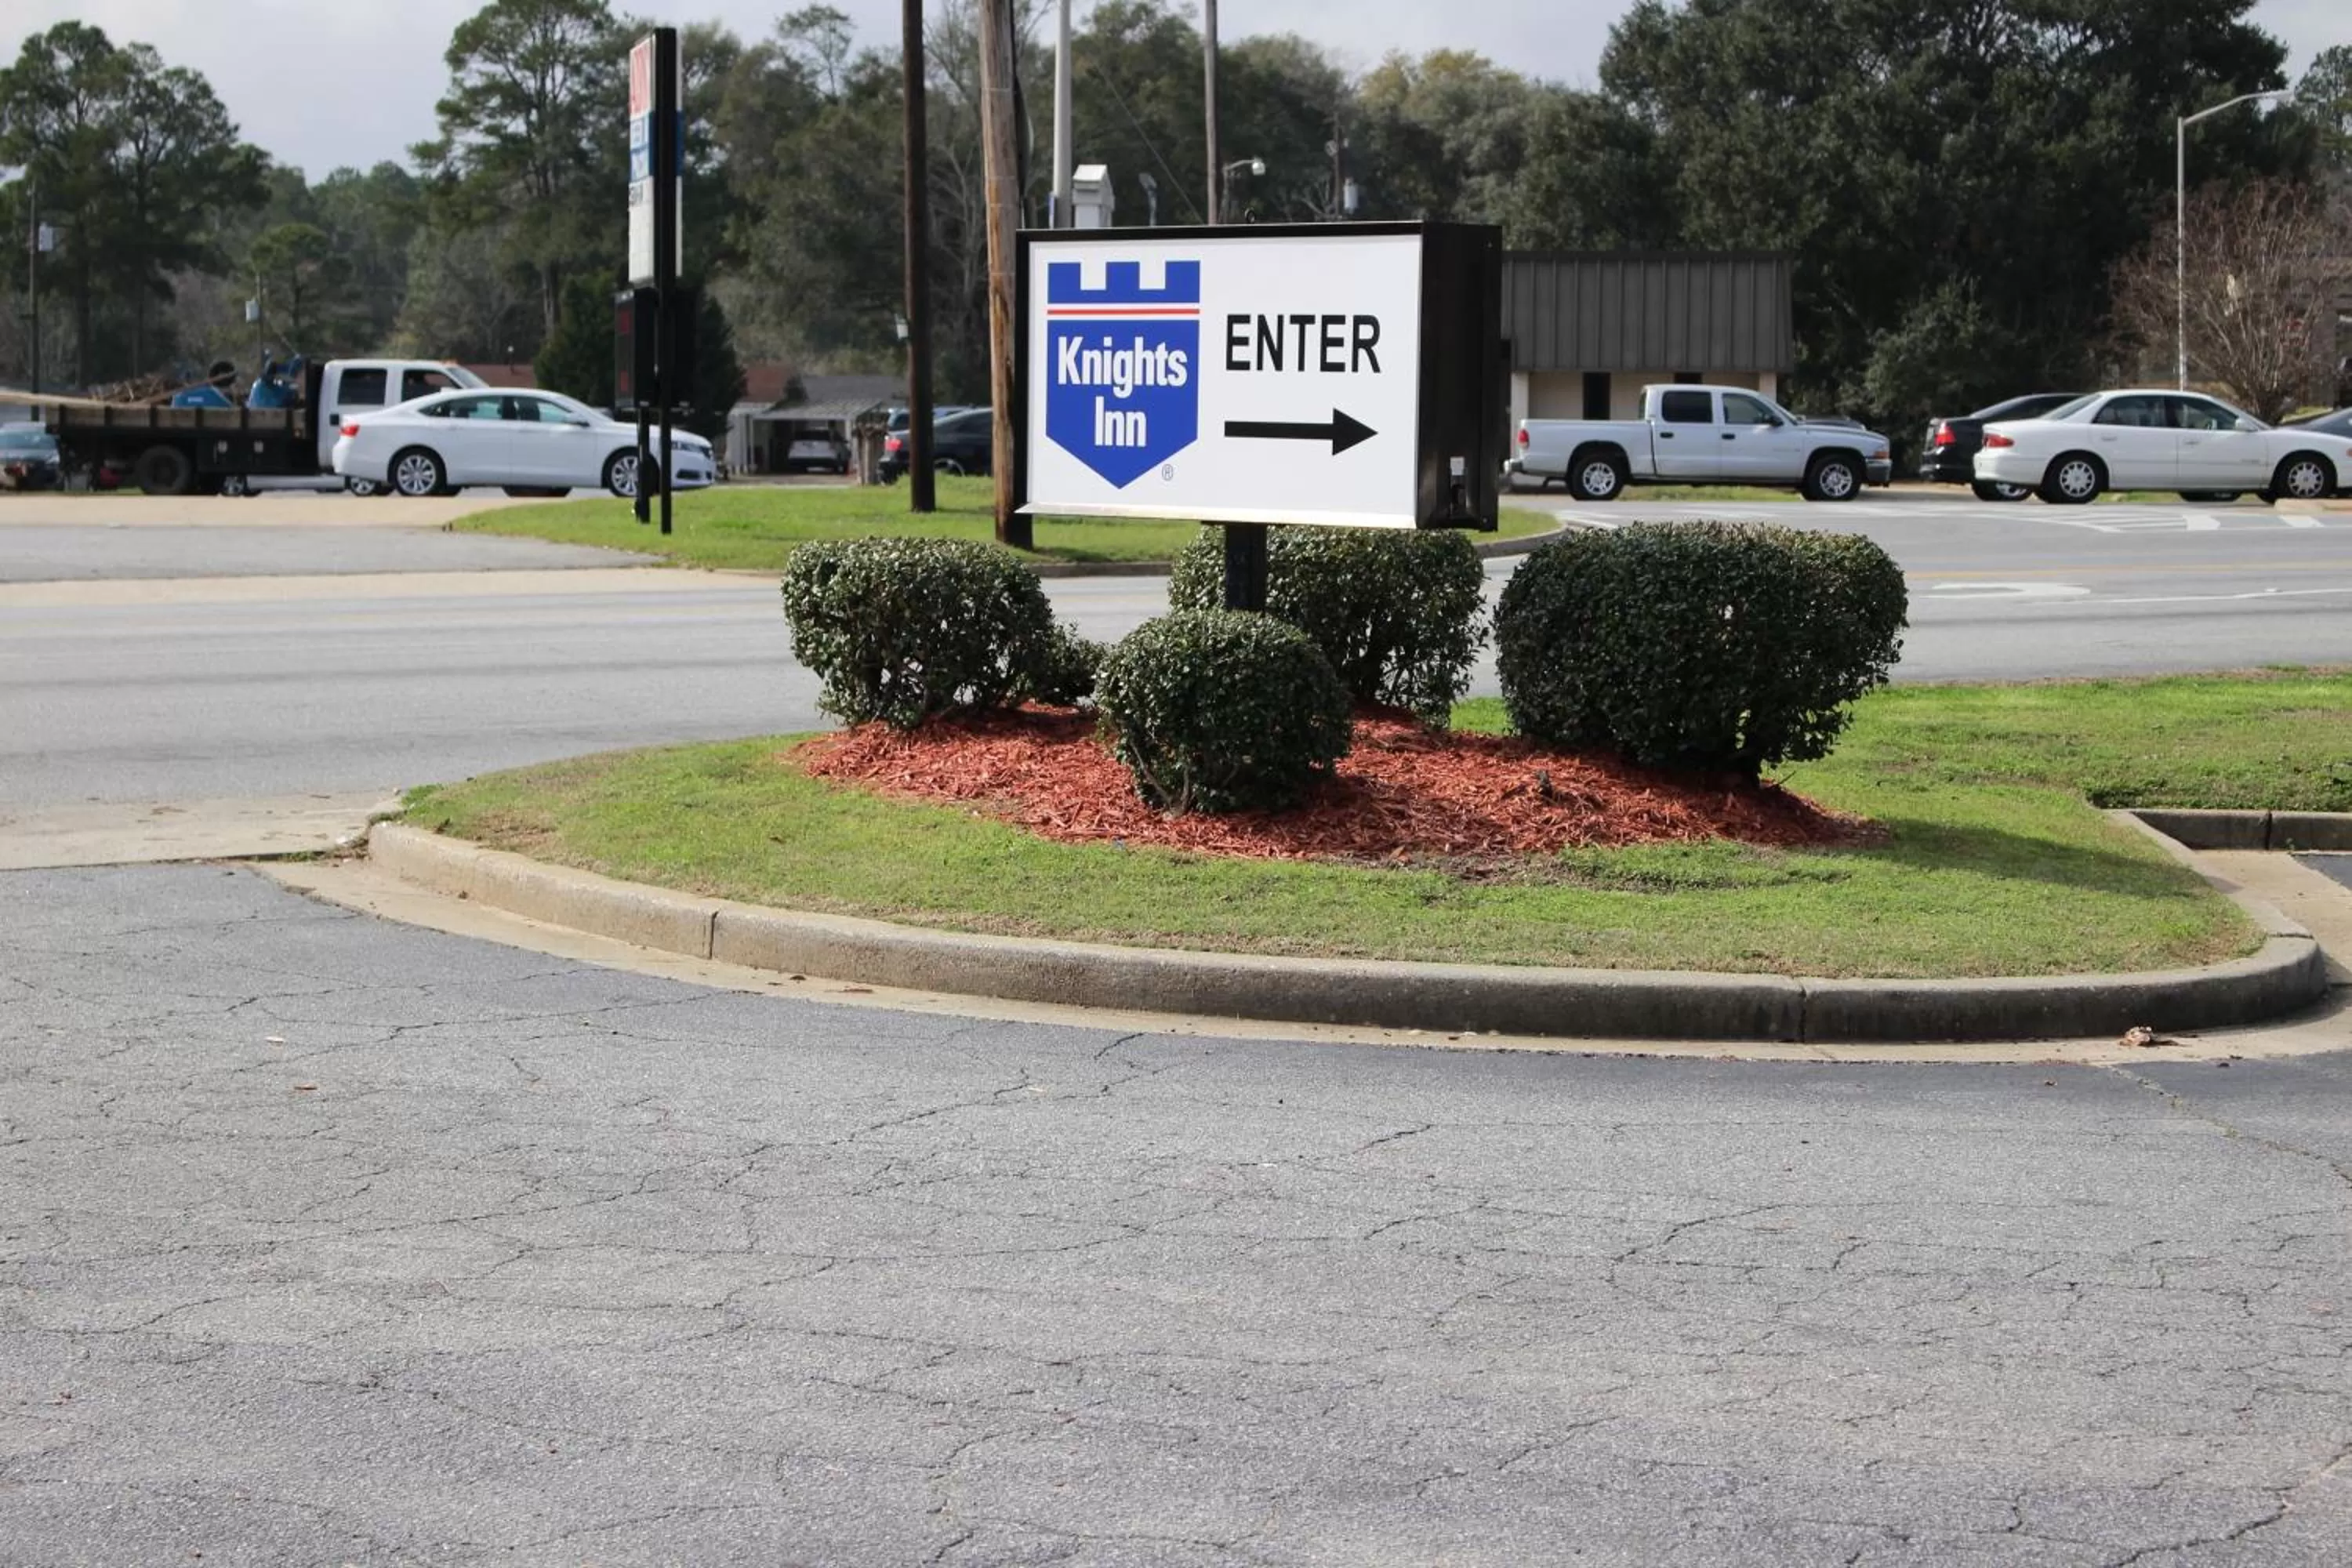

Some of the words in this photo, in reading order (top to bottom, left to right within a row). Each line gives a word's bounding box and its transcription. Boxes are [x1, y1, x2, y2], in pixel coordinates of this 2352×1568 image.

[1058, 336, 1188, 398] Knights
[1225, 314, 1381, 373] ENTER
[1094, 396, 1147, 448] Inn
